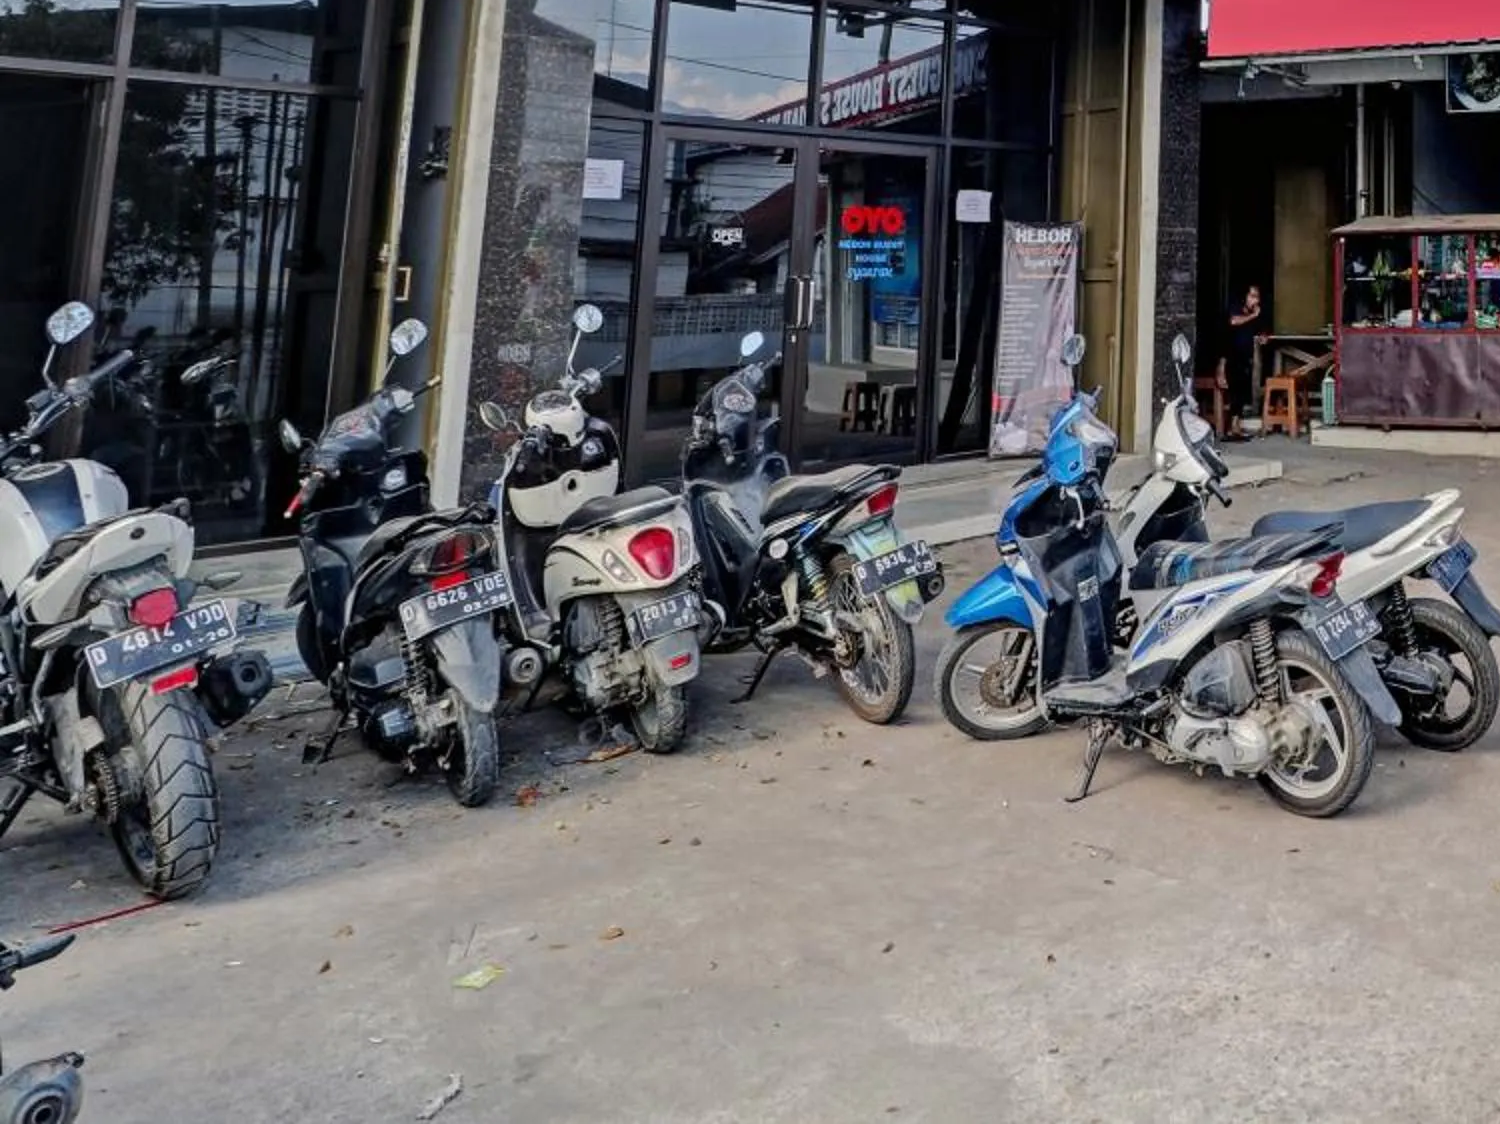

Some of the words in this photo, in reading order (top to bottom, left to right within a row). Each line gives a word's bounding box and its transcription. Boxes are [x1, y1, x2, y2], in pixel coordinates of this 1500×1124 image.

[840, 204, 906, 235] OYO
[712, 228, 743, 246] OPEN
[1015, 226, 1072, 244] HEBOH
[427, 586, 468, 610] 6626
[91, 645, 108, 666] D
